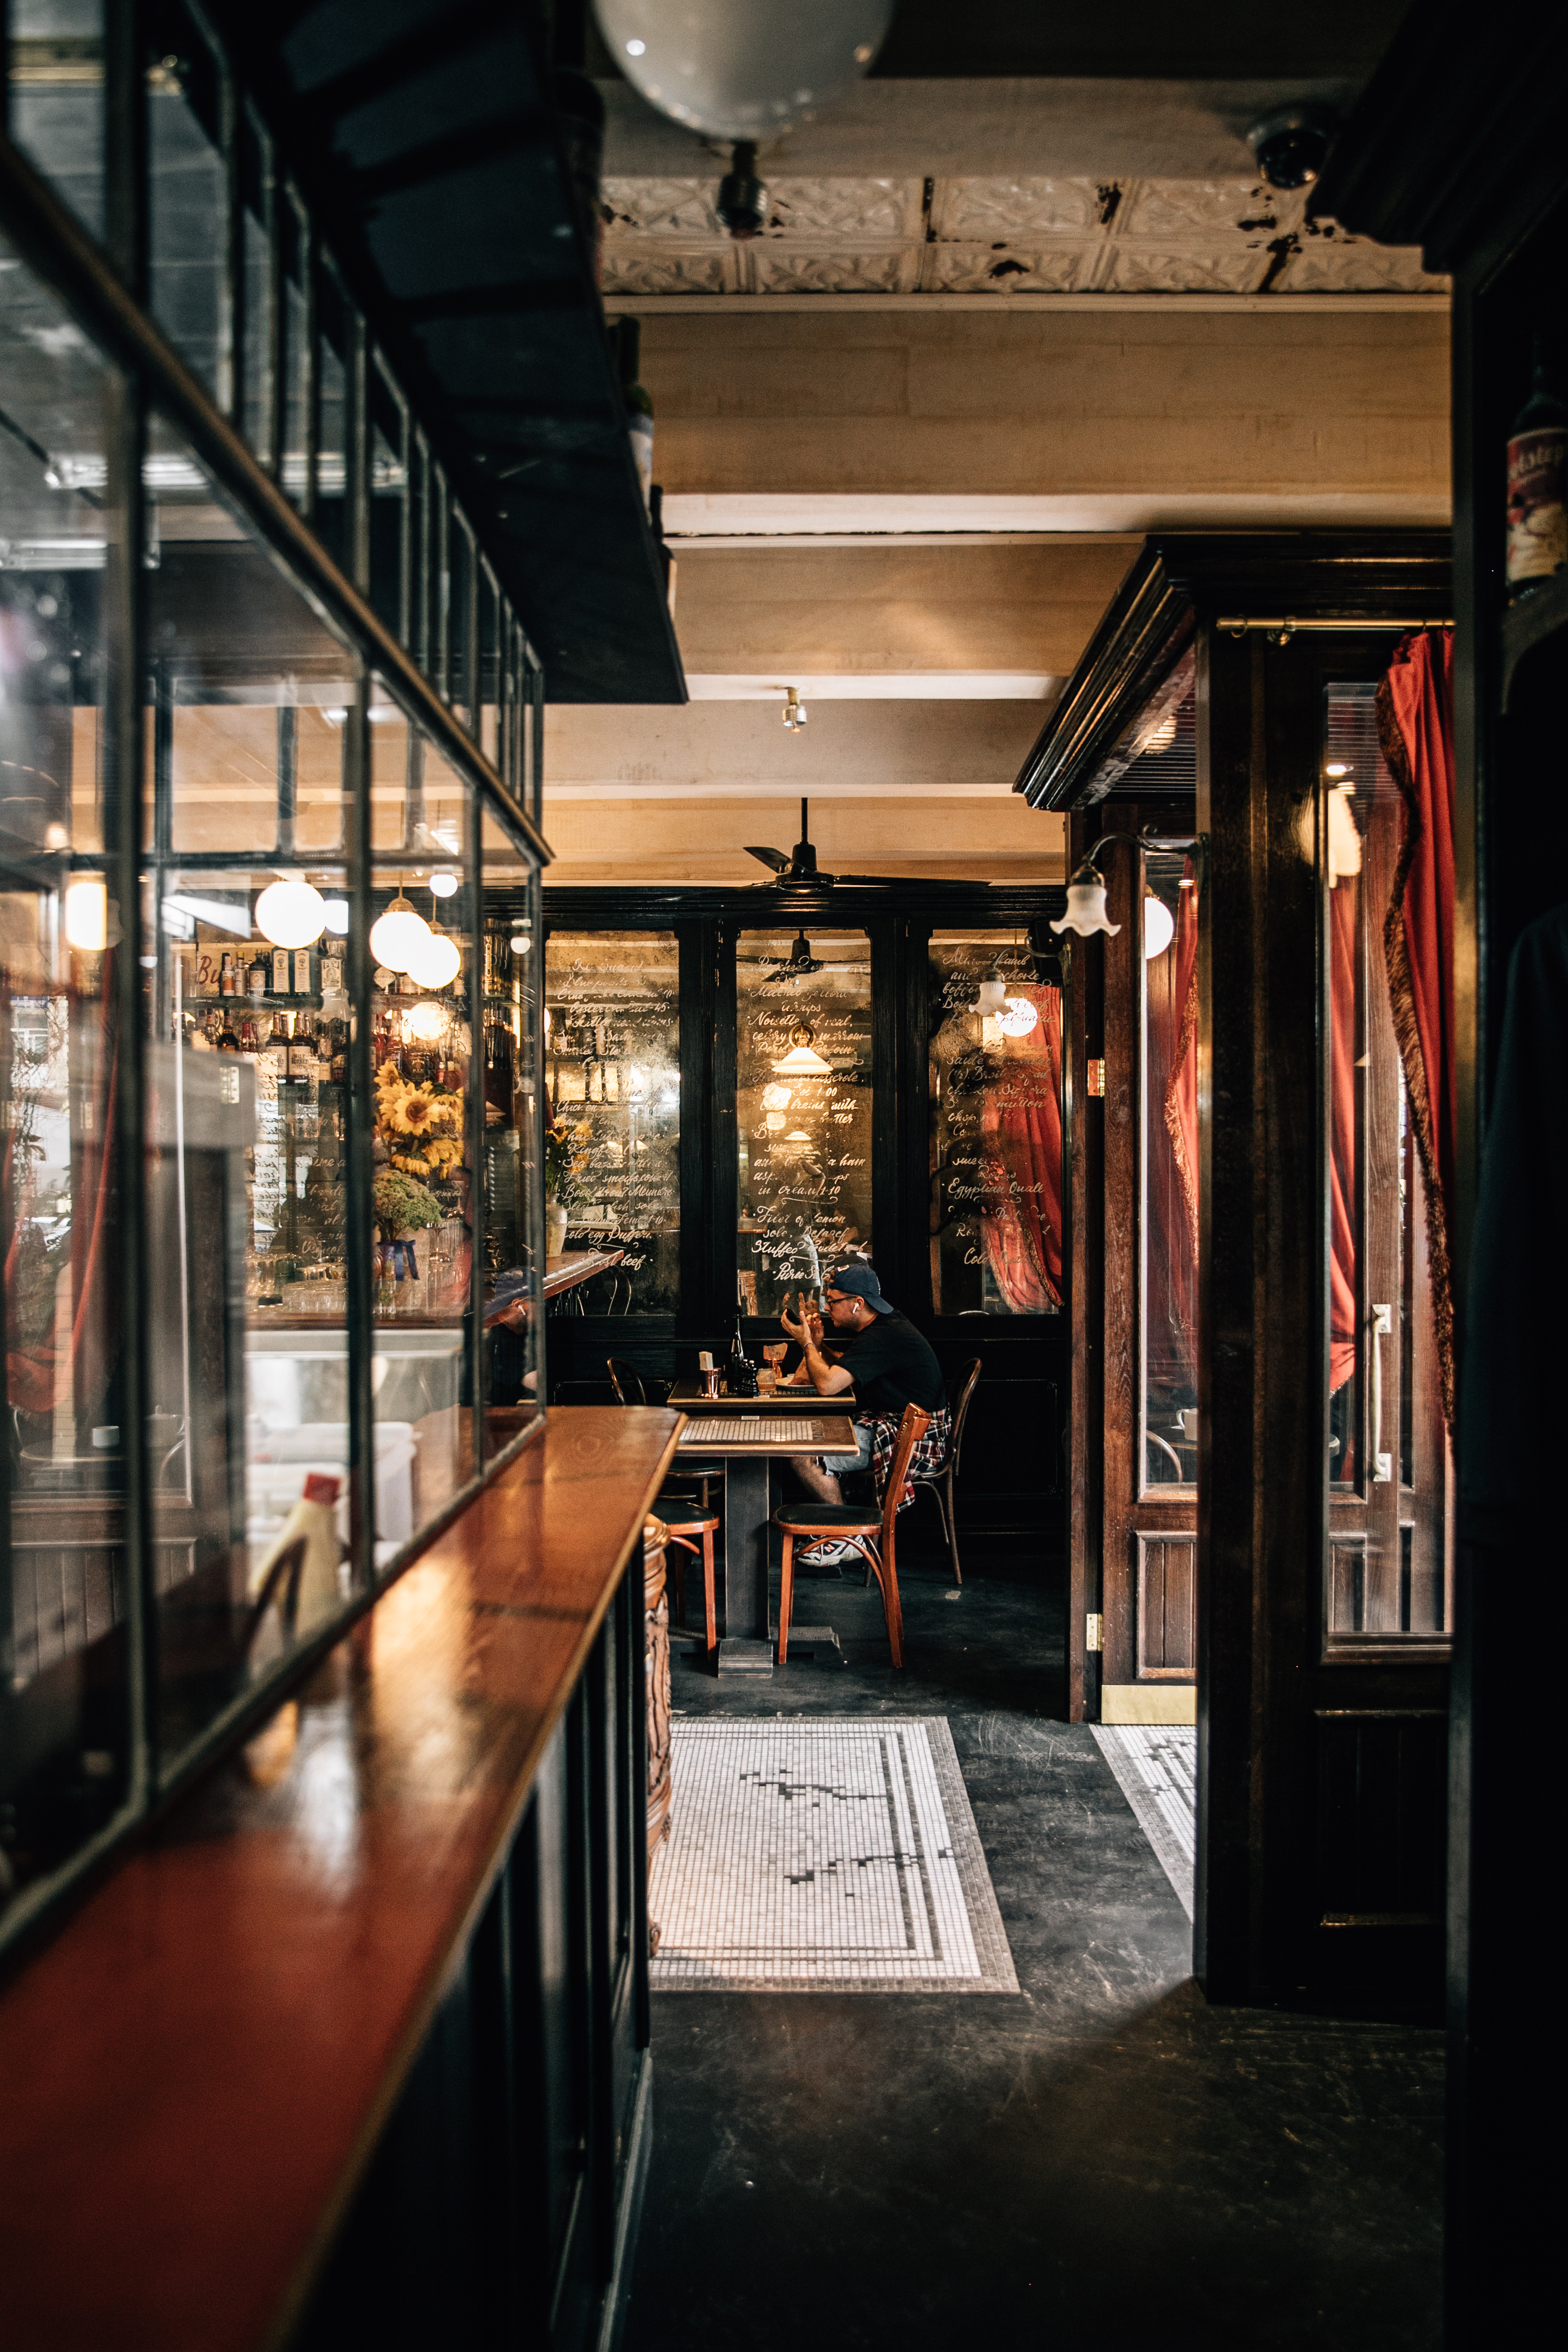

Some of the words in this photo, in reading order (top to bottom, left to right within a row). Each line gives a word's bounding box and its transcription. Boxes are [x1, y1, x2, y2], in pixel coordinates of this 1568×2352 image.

[810, 1013, 826, 1029] of
[758, 1185, 770, 1195] in
[588, 1230, 605, 1246] egg
[824, 1544, 835, 1553] N
